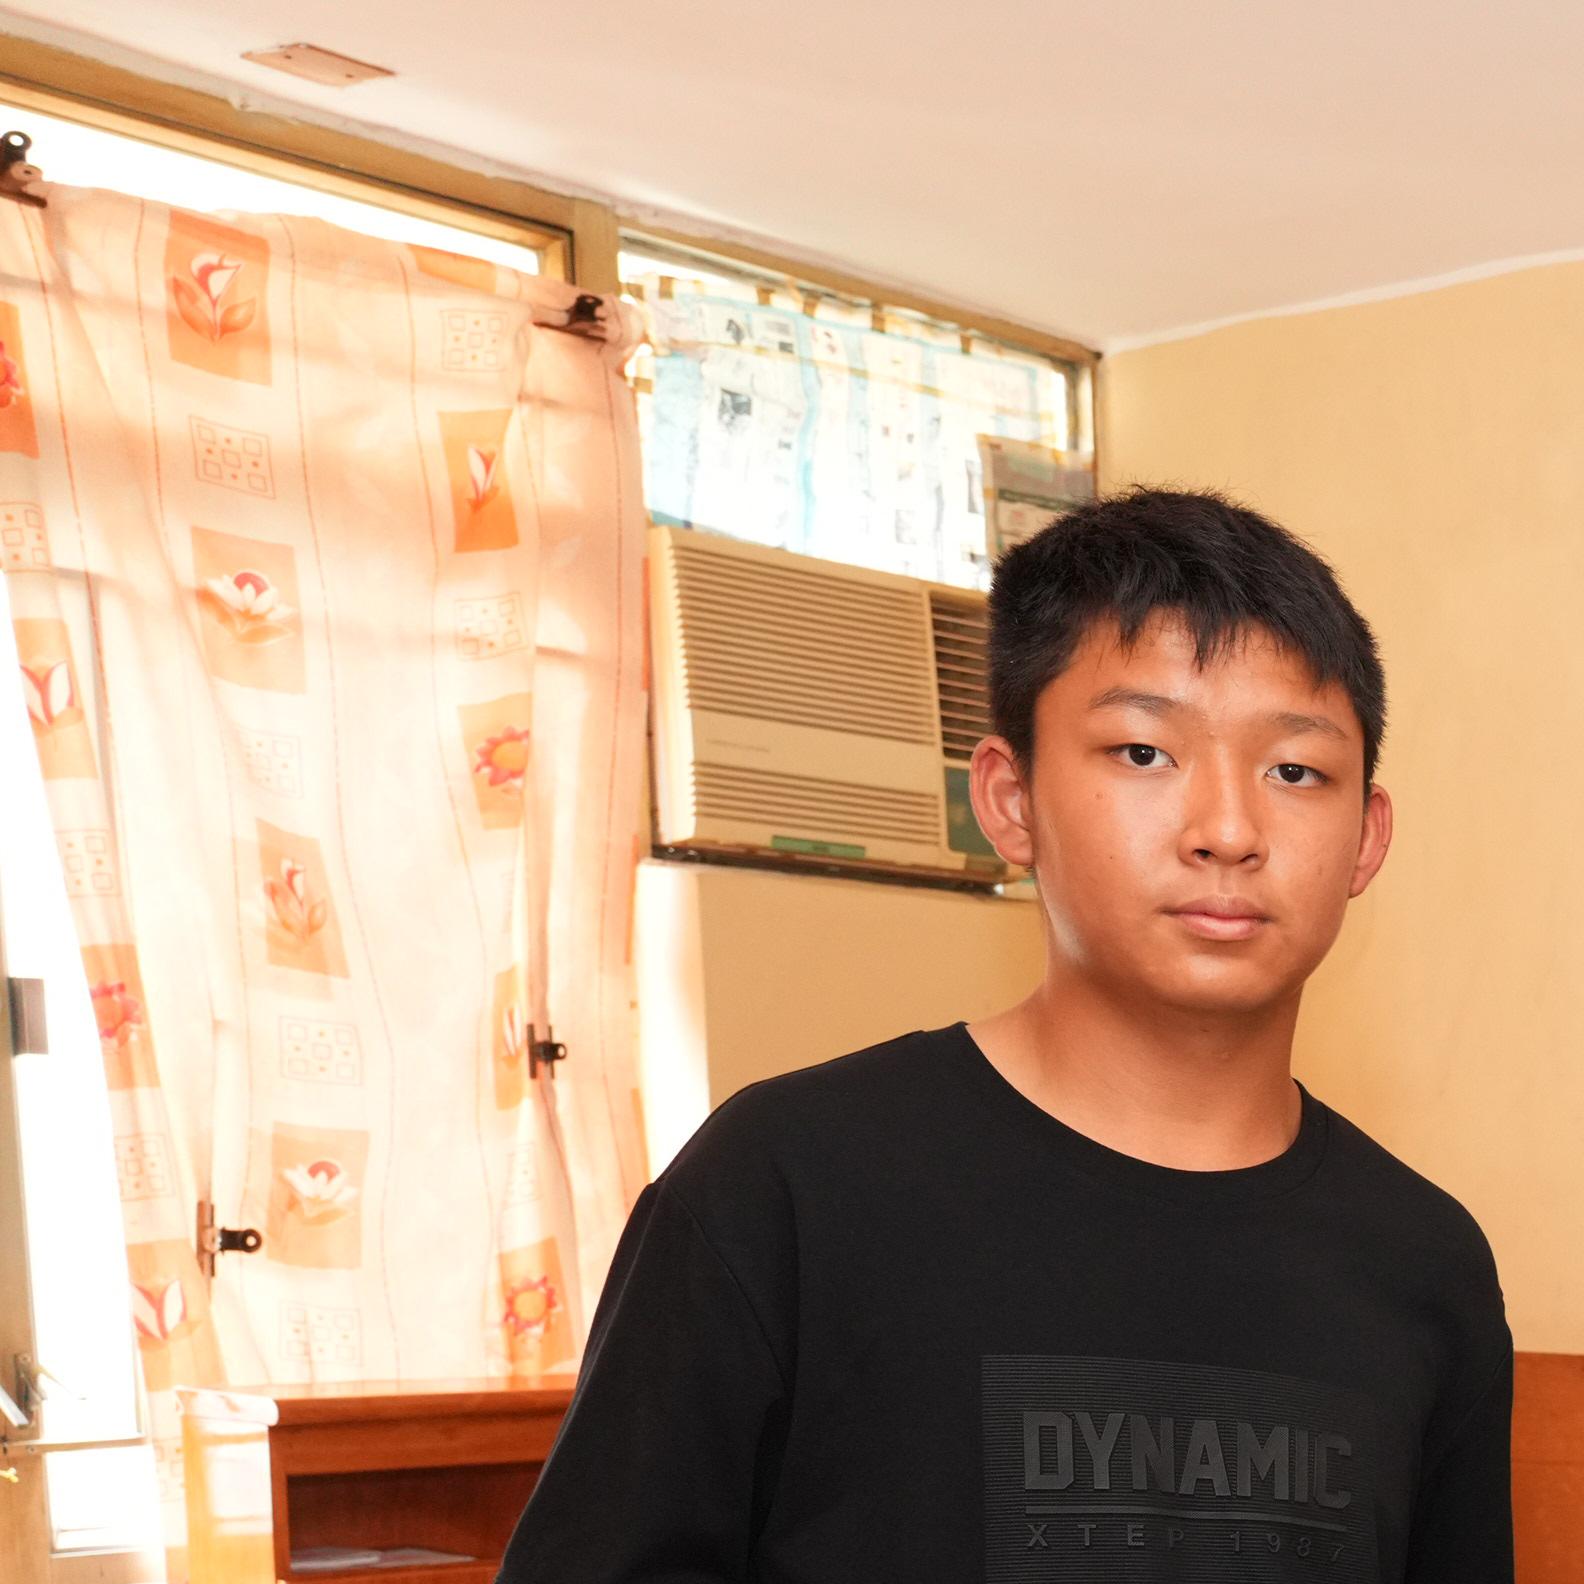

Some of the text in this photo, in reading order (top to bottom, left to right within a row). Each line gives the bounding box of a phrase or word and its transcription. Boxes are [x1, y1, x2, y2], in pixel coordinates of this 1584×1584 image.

[1023, 1410, 1352, 1510] DYNAMIC
[1026, 1523, 1346, 1564] XTEP 1987
